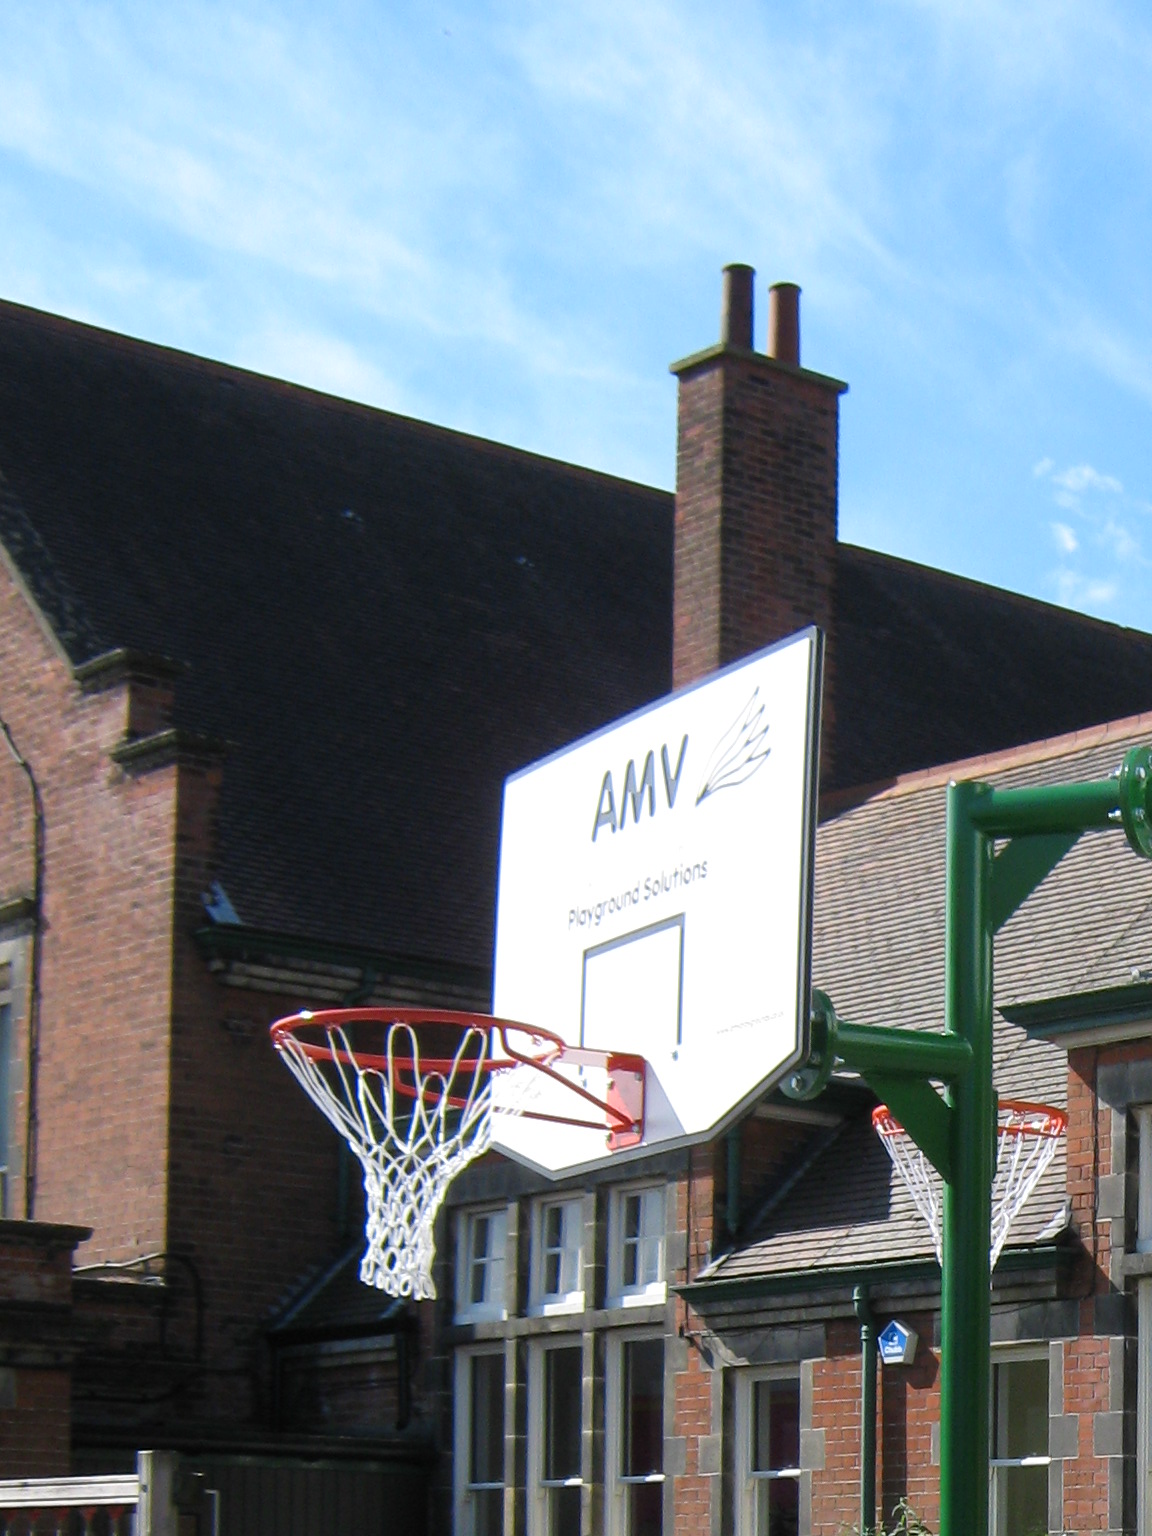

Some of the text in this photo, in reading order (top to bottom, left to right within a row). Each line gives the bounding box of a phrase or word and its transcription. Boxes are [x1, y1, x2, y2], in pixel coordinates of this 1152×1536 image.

[591, 733, 689, 843] AMV
[568, 860, 708, 931] Playground Solutions
